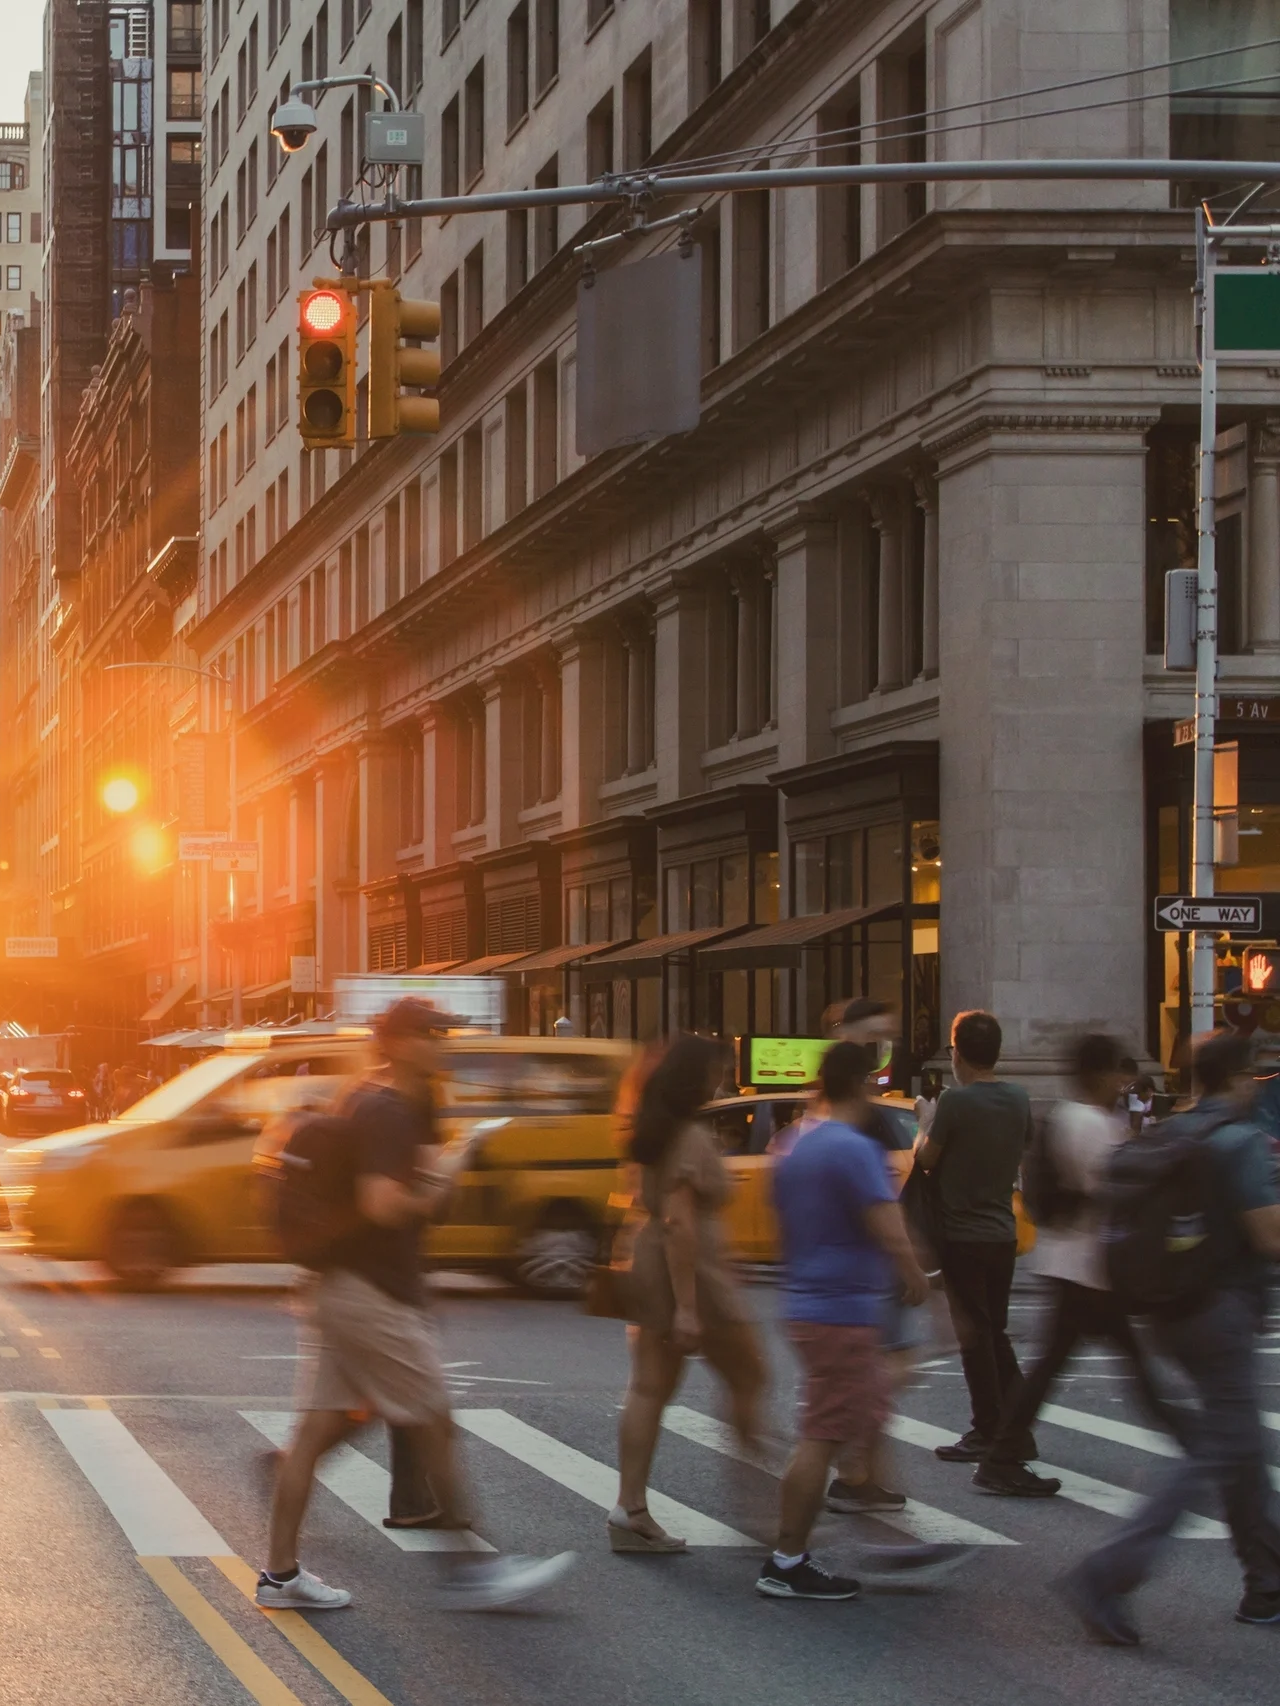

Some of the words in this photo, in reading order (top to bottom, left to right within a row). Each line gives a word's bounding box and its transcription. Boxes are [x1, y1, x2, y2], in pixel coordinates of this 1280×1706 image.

[1236, 702, 1244, 717] 5
[1251, 702, 1269, 718] Av
[1169, 907, 1201, 921] ONE
[1218, 908, 1251, 921] WAY
